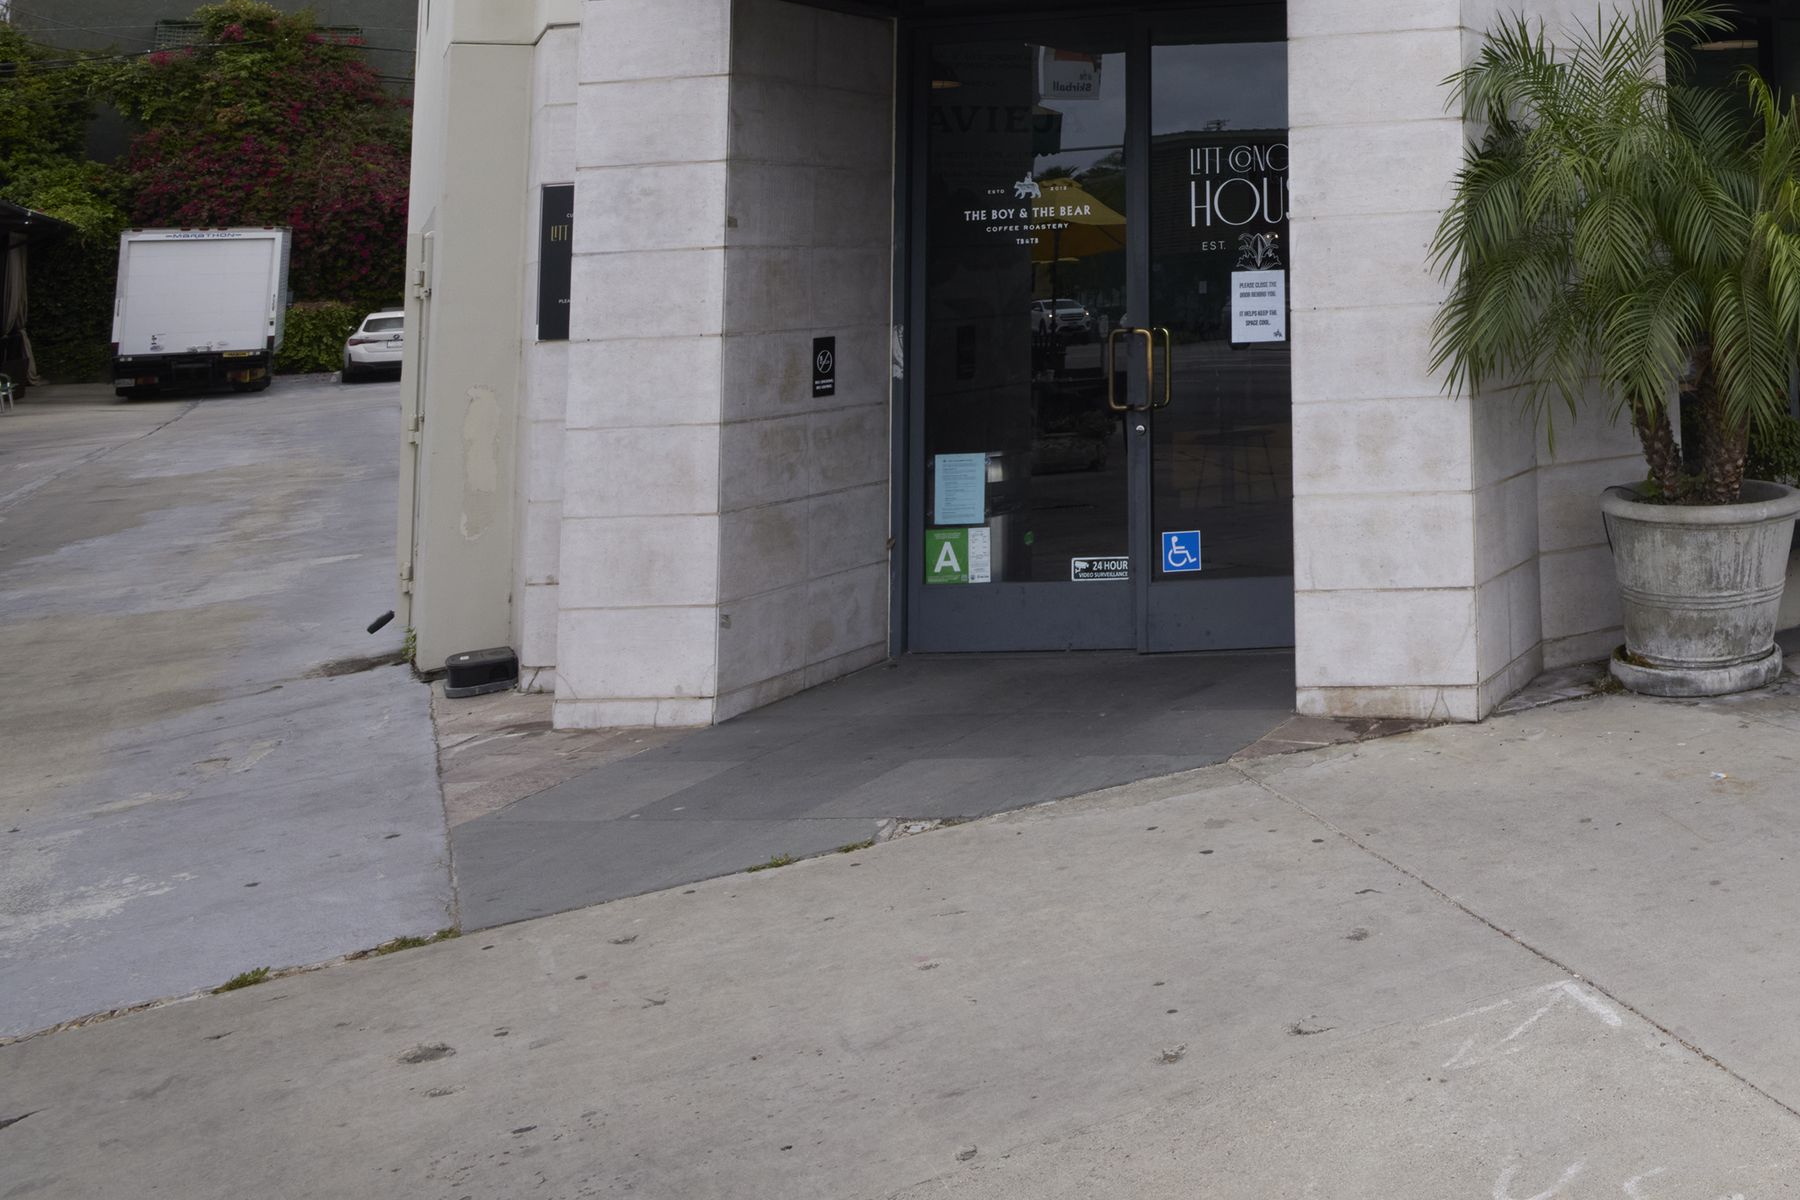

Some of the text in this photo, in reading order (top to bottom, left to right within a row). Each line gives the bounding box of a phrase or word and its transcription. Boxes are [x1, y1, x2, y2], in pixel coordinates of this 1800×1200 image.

[1190, 146, 1223, 175] LITT
[1191, 176, 1290, 227] HOU
[964, 205, 1091, 221] THE BOY & THE BEAR
[551, 224, 569, 242] LITT
[1023, 223, 1069, 231] ROASTERY
[1202, 241, 1226, 250] EST.
[934, 541, 961, 573] A
[1092, 560, 1128, 570] 24 HOUR
